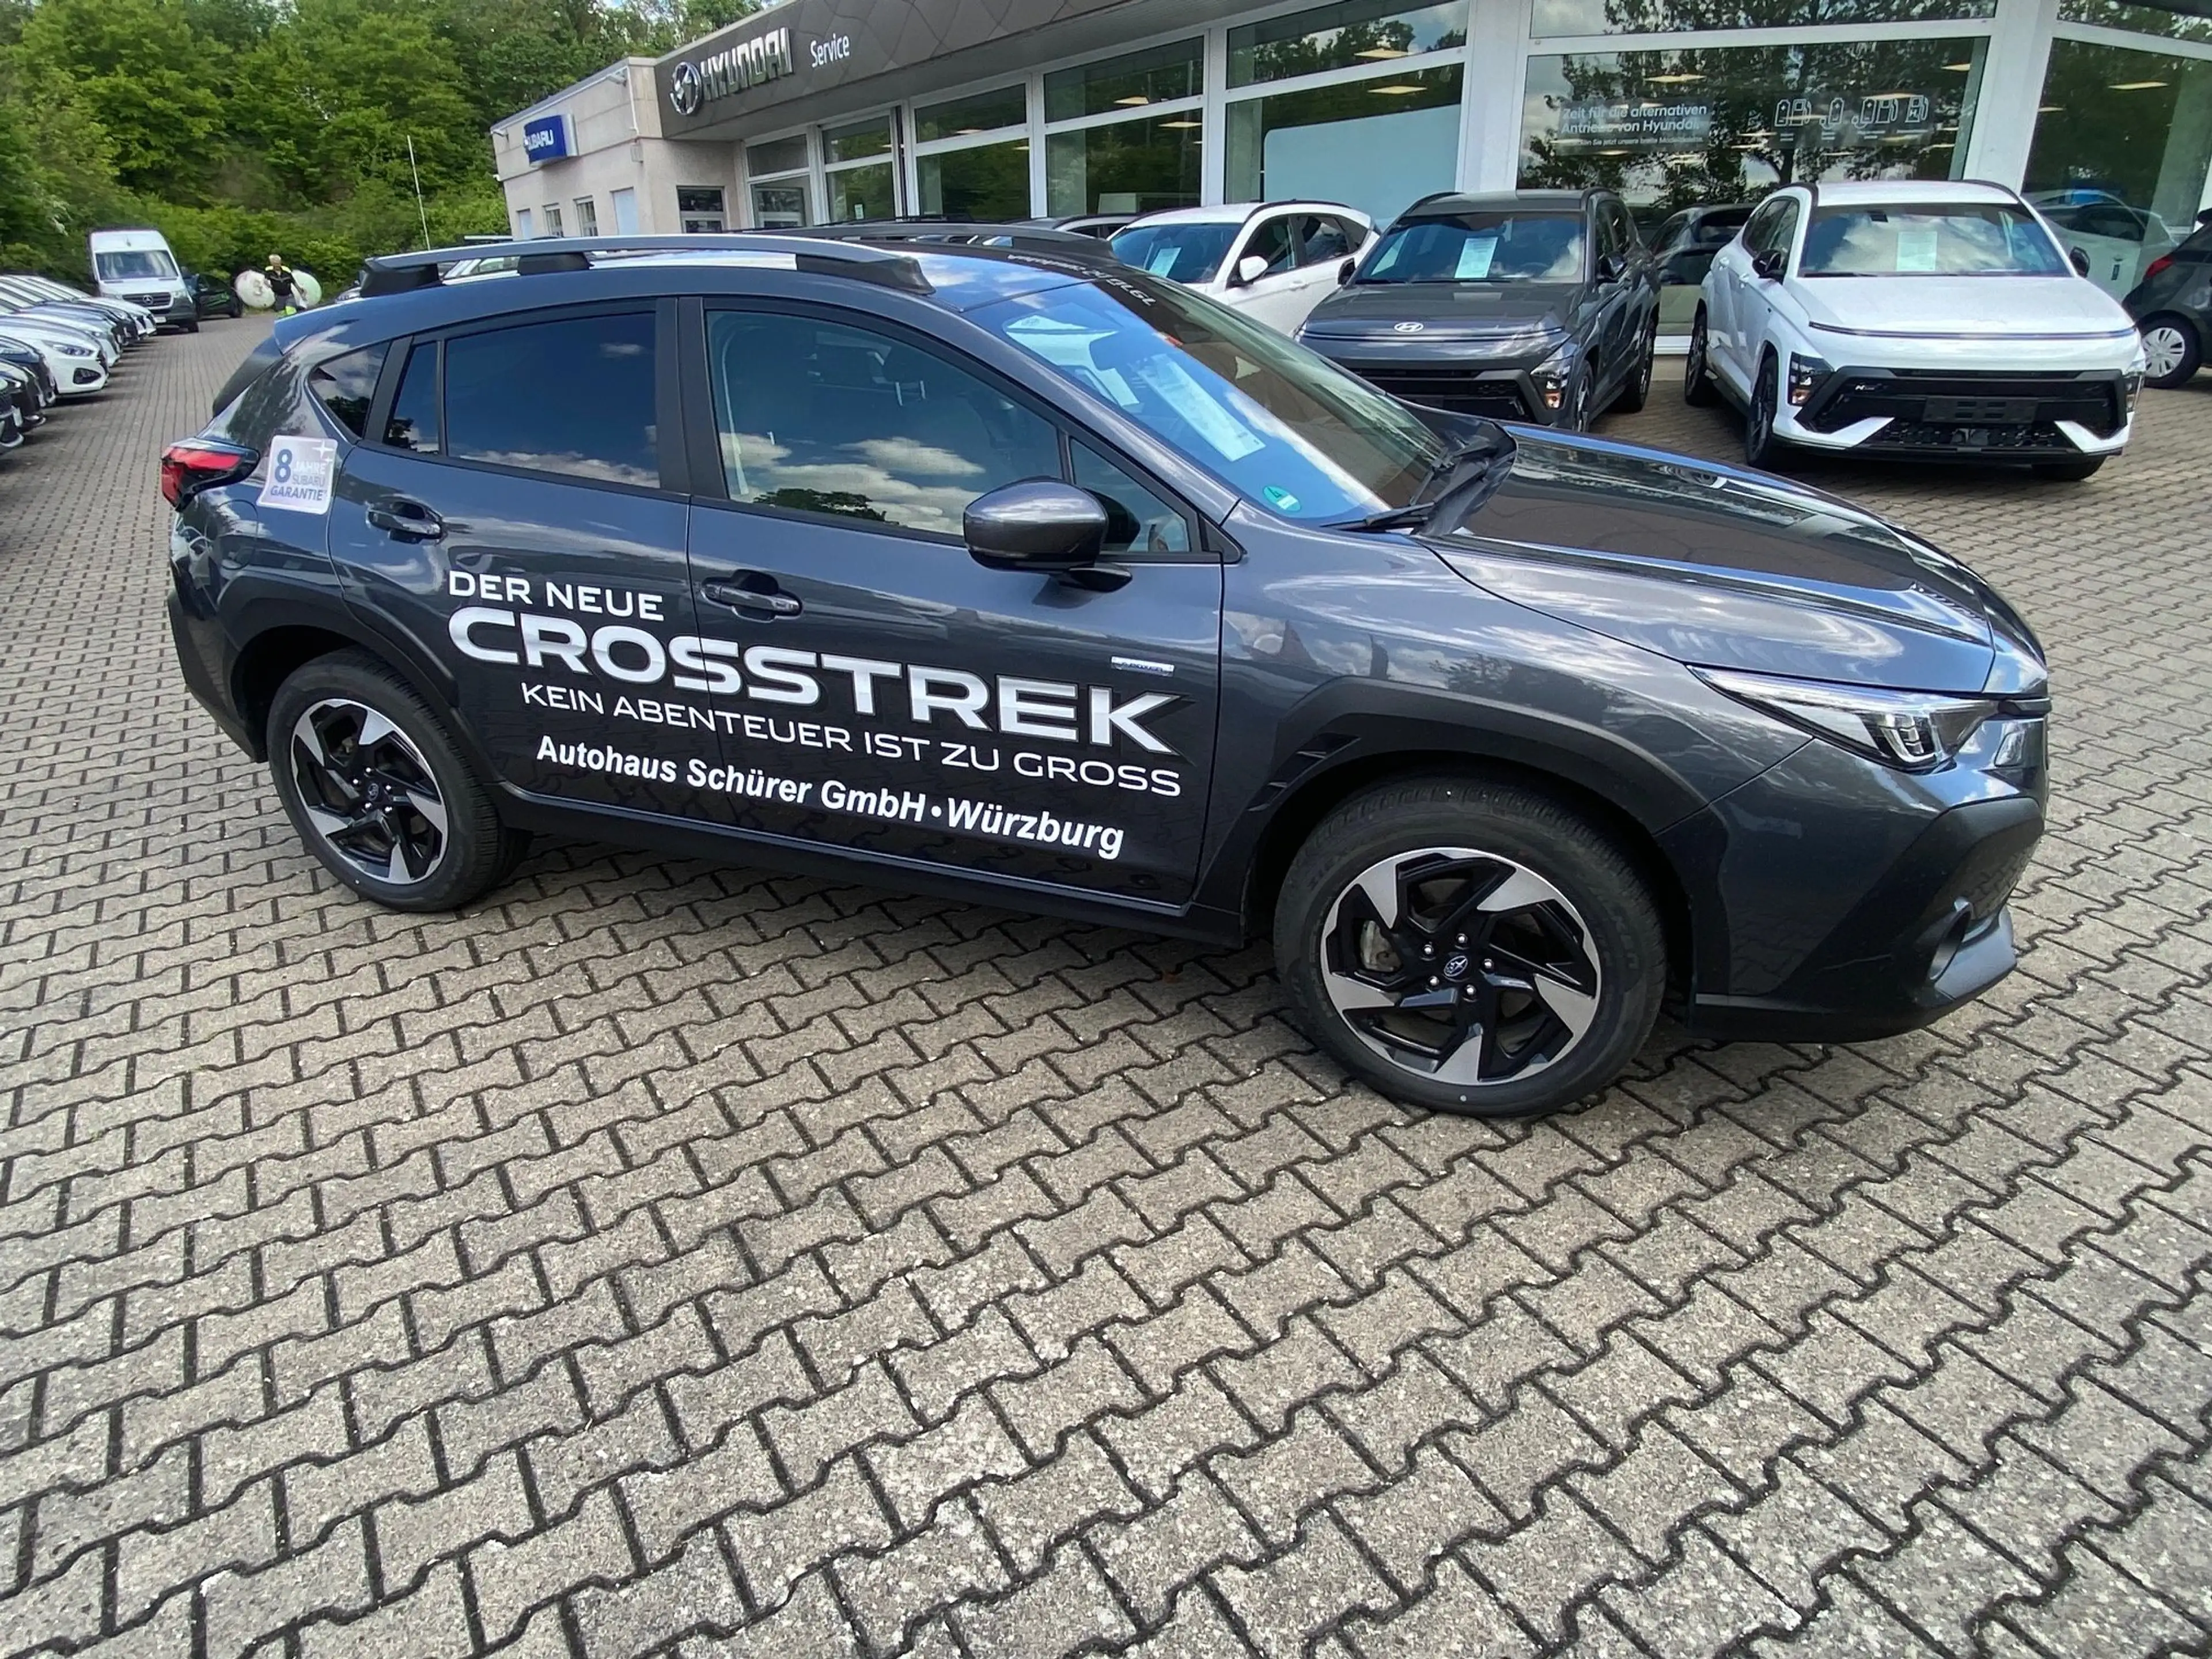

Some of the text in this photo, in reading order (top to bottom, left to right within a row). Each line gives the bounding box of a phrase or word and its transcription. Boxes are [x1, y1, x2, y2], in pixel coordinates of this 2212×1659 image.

[700, 27, 850, 102] HYUNDAI Service
[1562, 107, 1585, 120] Zeit
[1630, 104, 1707, 117] alternativen
[1618, 123, 1640, 132] von
[275, 449, 293, 483] 8
[292, 474, 325, 487] SUBARU
[295, 460, 326, 475] JAHRE
[449, 570, 664, 621] DER NEUE
[448, 607, 1179, 754] CROSSTREK
[521, 682, 1180, 796] KEIN ABENTEUER IST ZU GROSS
[536, 735, 1124, 860] Autohaus Schürer GmbH Würzburg
